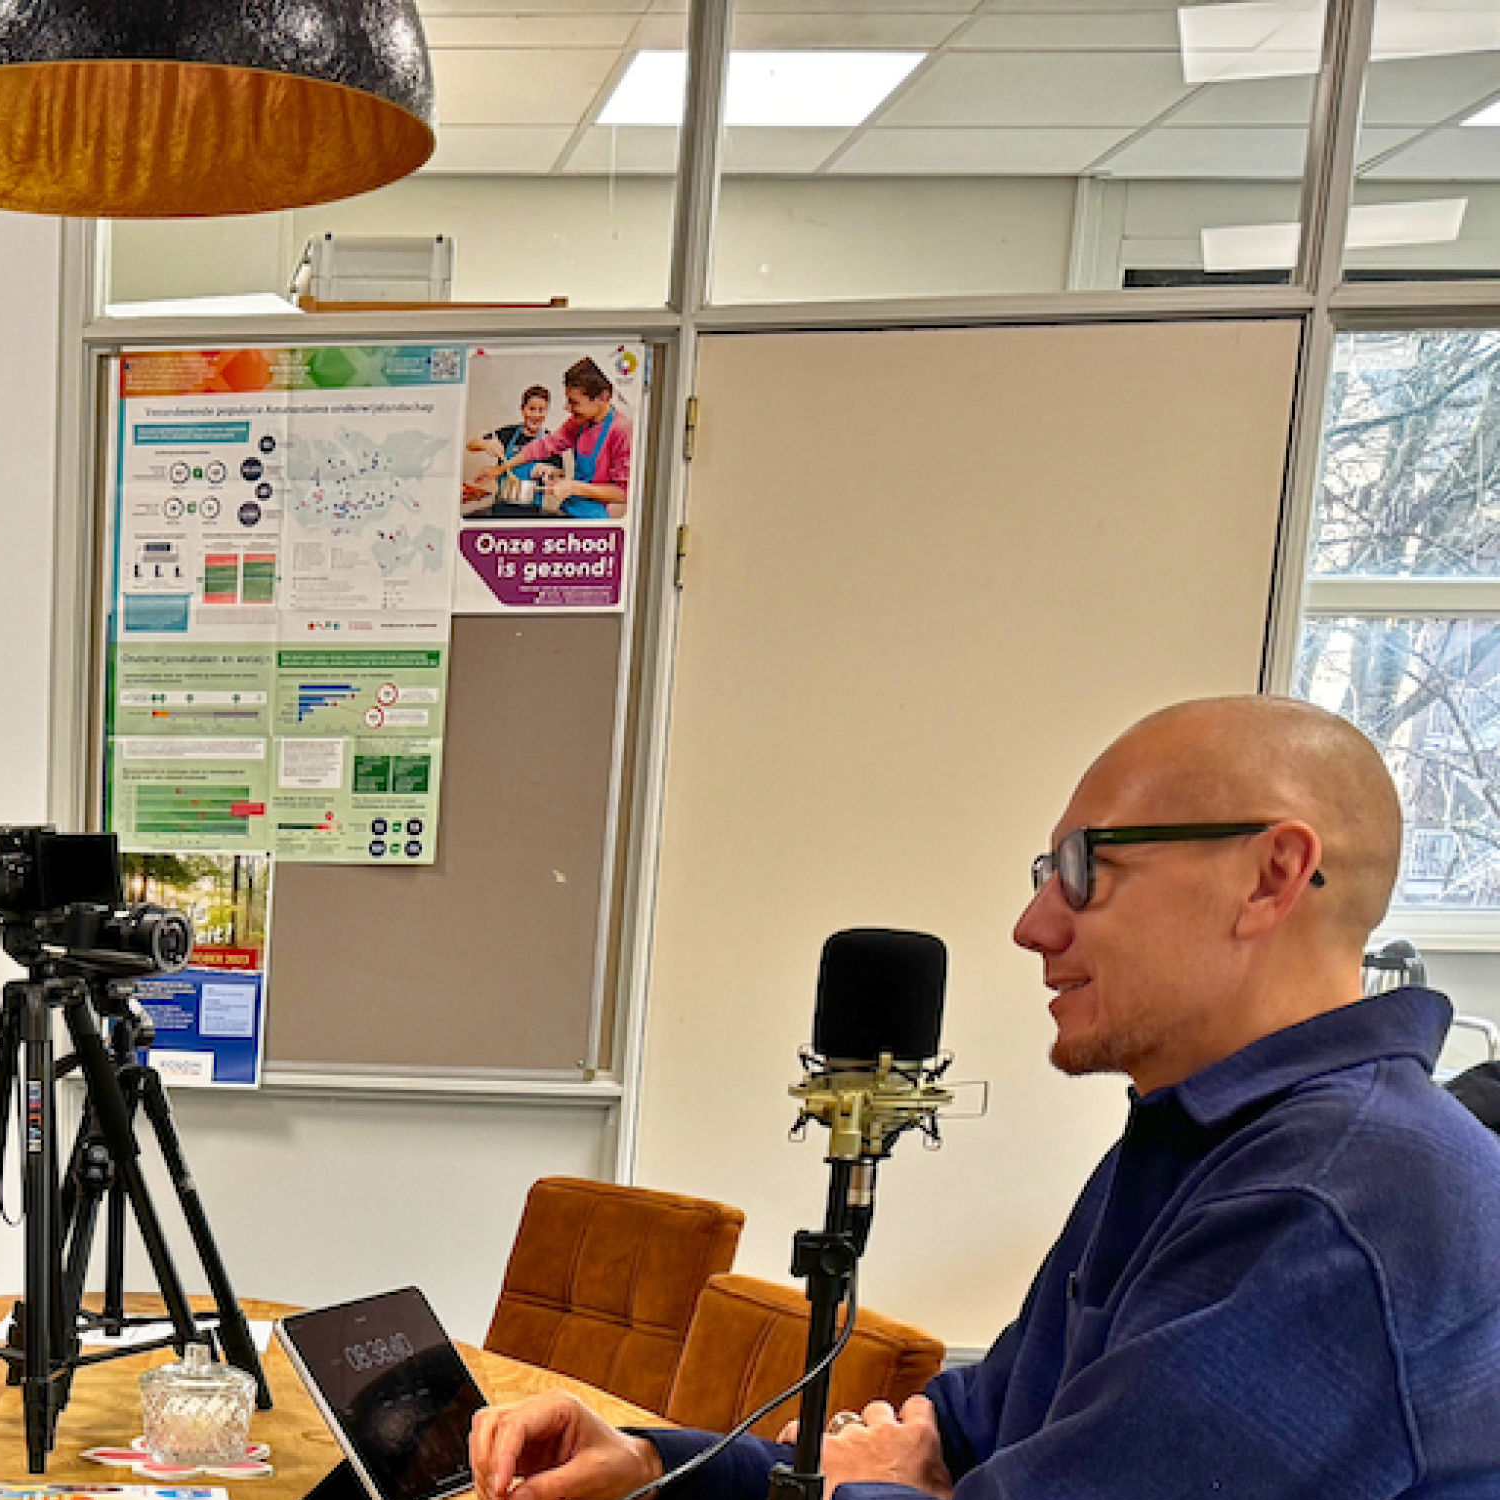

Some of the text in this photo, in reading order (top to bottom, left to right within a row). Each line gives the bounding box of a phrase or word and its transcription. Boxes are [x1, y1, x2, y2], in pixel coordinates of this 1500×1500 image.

[476, 531, 616, 554] Onze school
[497, 555, 614, 583] is gezond!
